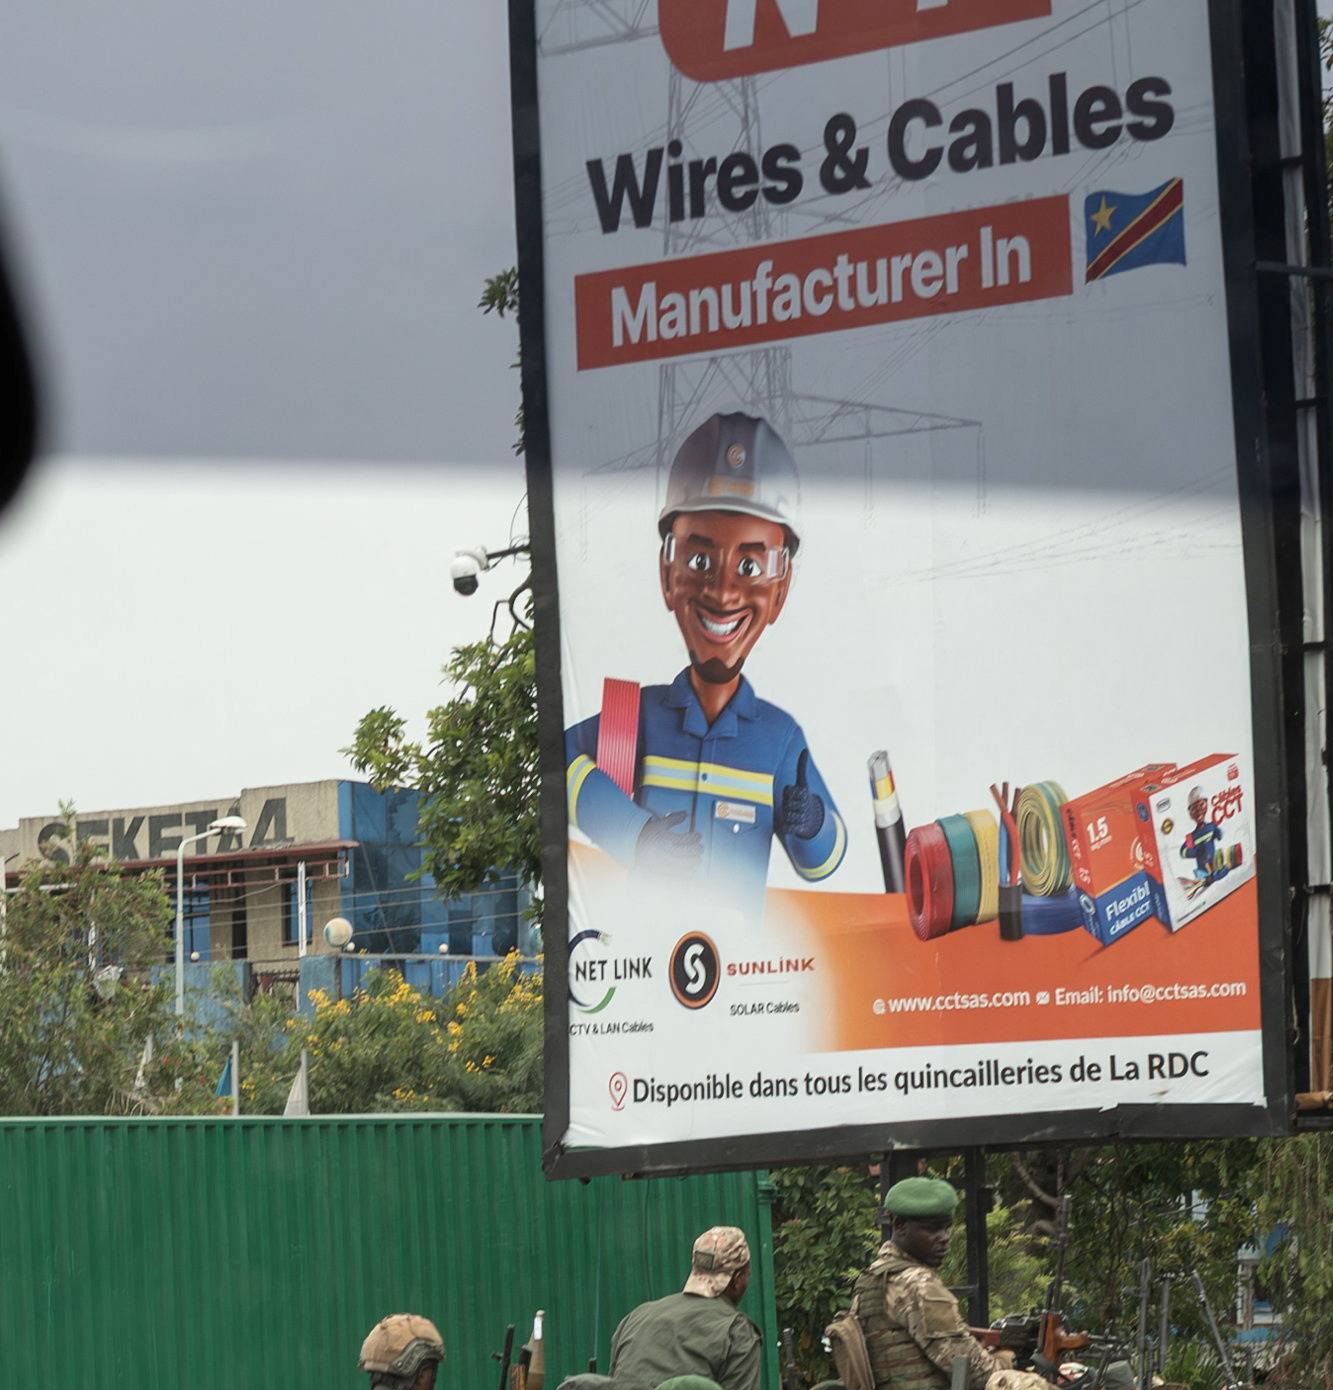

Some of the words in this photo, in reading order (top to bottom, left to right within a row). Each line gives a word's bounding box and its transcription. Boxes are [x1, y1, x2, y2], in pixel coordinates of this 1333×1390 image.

[586, 139, 804, 234] Wires
[819, 112, 873, 196] &
[887, 71, 1175, 182] Cables
[611, 242, 969, 348] Manufacturer
[981, 225, 1032, 289] In
[575, 959, 607, 982] NET
[614, 957, 653, 979] LINK
[730, 1003, 764, 1017] SOLAR
[766, 1002, 800, 1014] Cables
[889, 989, 1031, 1013] www.cctsas.com
[1055, 987, 1104, 1006] Email:
[1108, 981, 1247, 1003] info@cctsas.com
[601, 1022, 621, 1034] LAN
[633, 1074, 743, 1107] Disponible
[750, 1072, 798, 1097] dans
[805, 1073, 851, 1095] tous
[858, 1067, 887, 1092] les
[894, 1057, 1063, 1096] quincailleries
[1070, 1055, 1101, 1082] de
[1109, 1053, 1140, 1081] La
[1148, 1051, 1210, 1079] RDC
